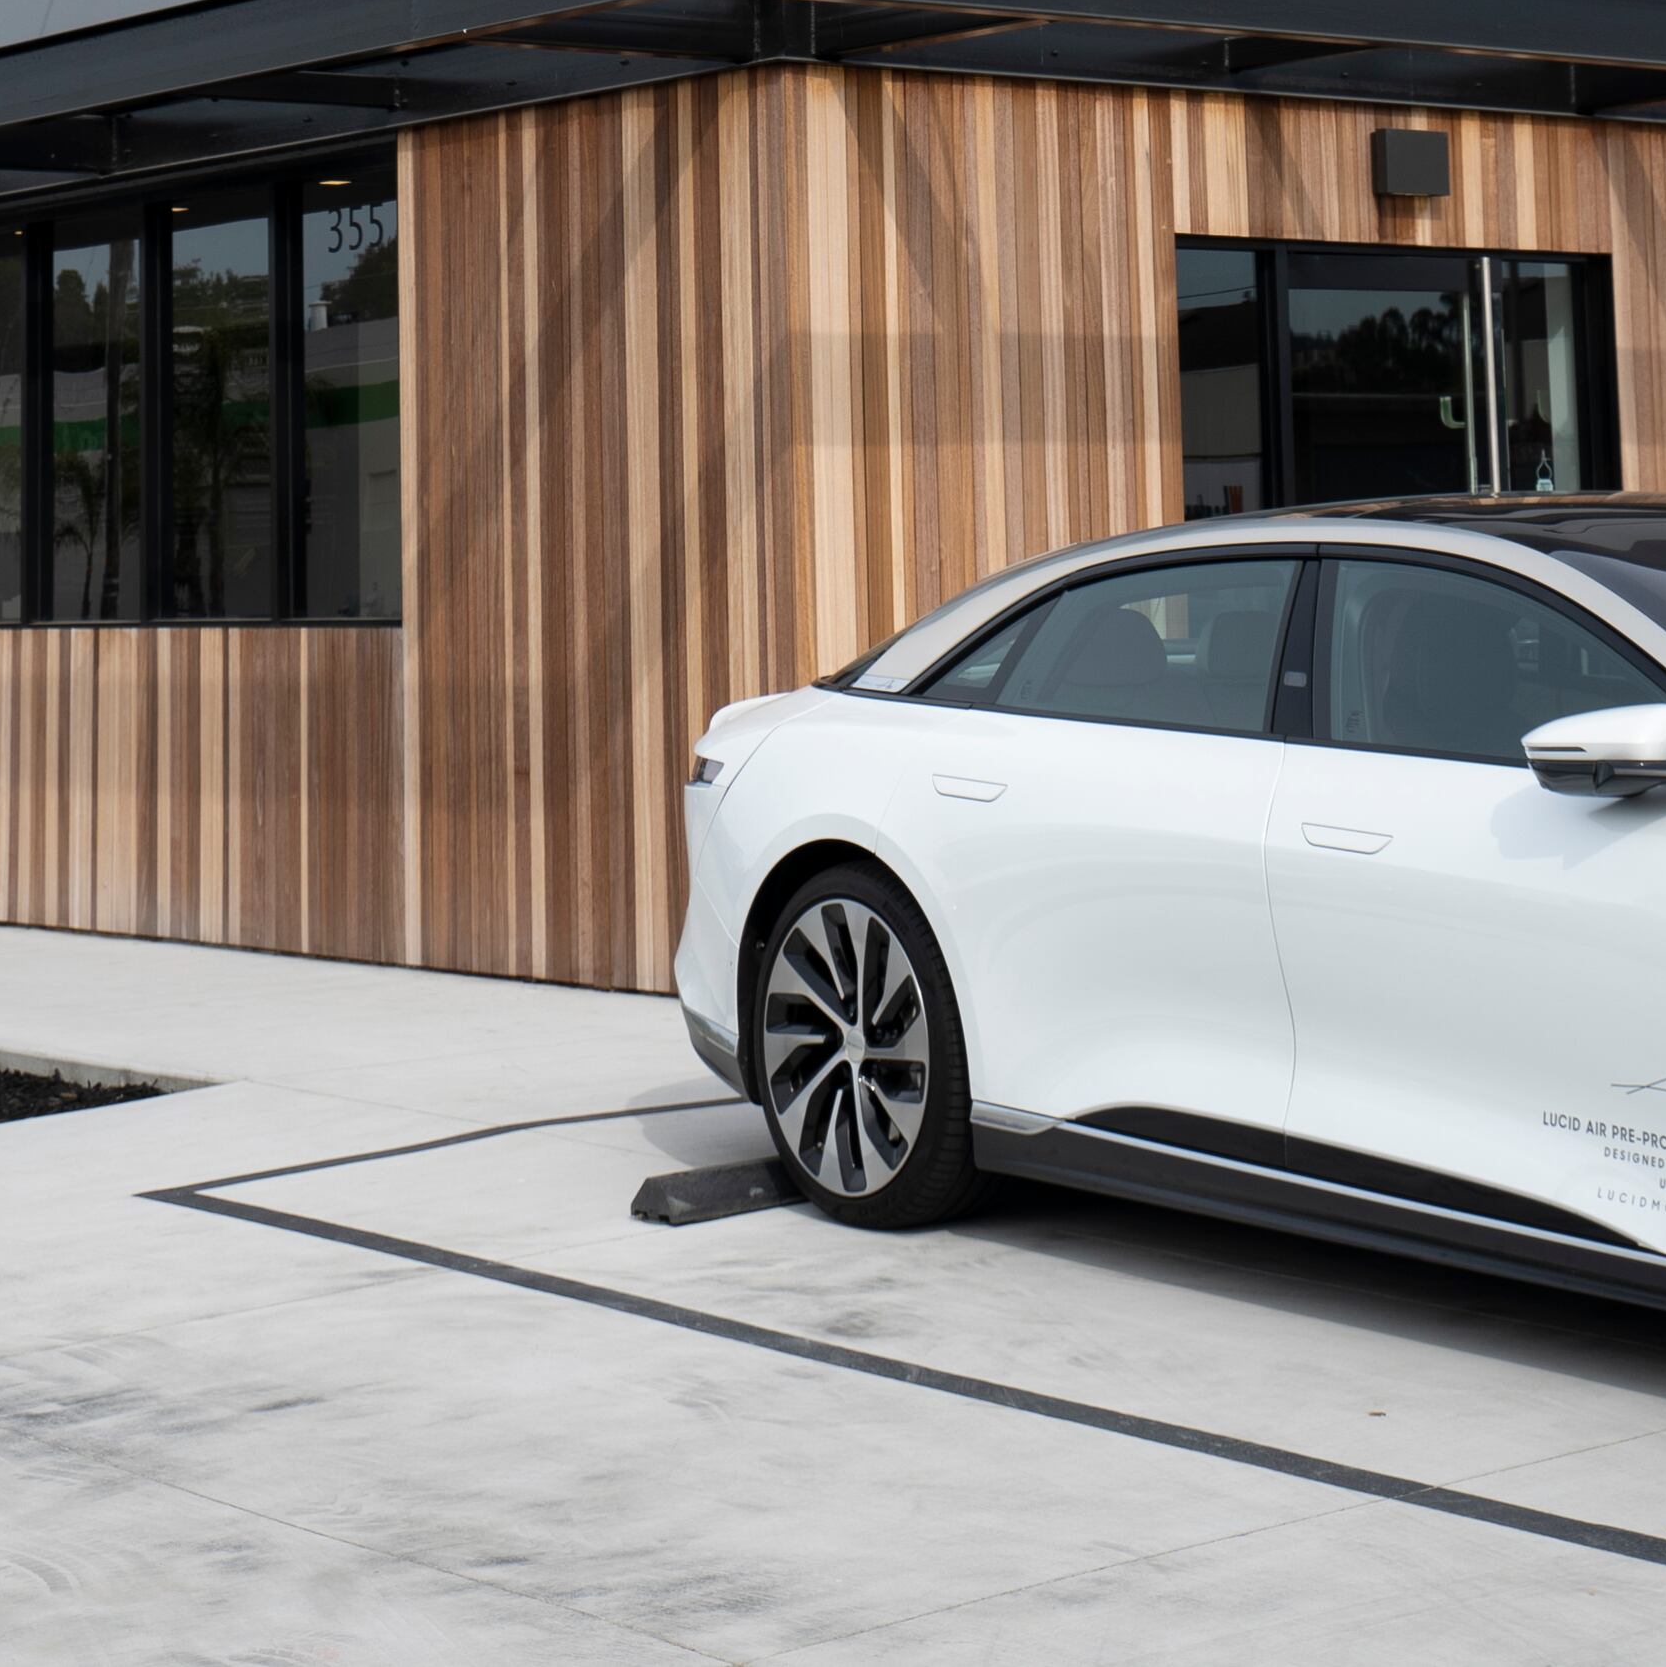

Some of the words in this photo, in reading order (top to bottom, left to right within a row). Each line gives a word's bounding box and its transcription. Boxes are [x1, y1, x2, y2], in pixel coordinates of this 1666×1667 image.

[327, 202, 384, 253] 355
[1542, 1111, 1581, 1132] LUCID
[1585, 1120, 1607, 1138] AIR
[1603, 1146, 1665, 1169] DESIGNED
